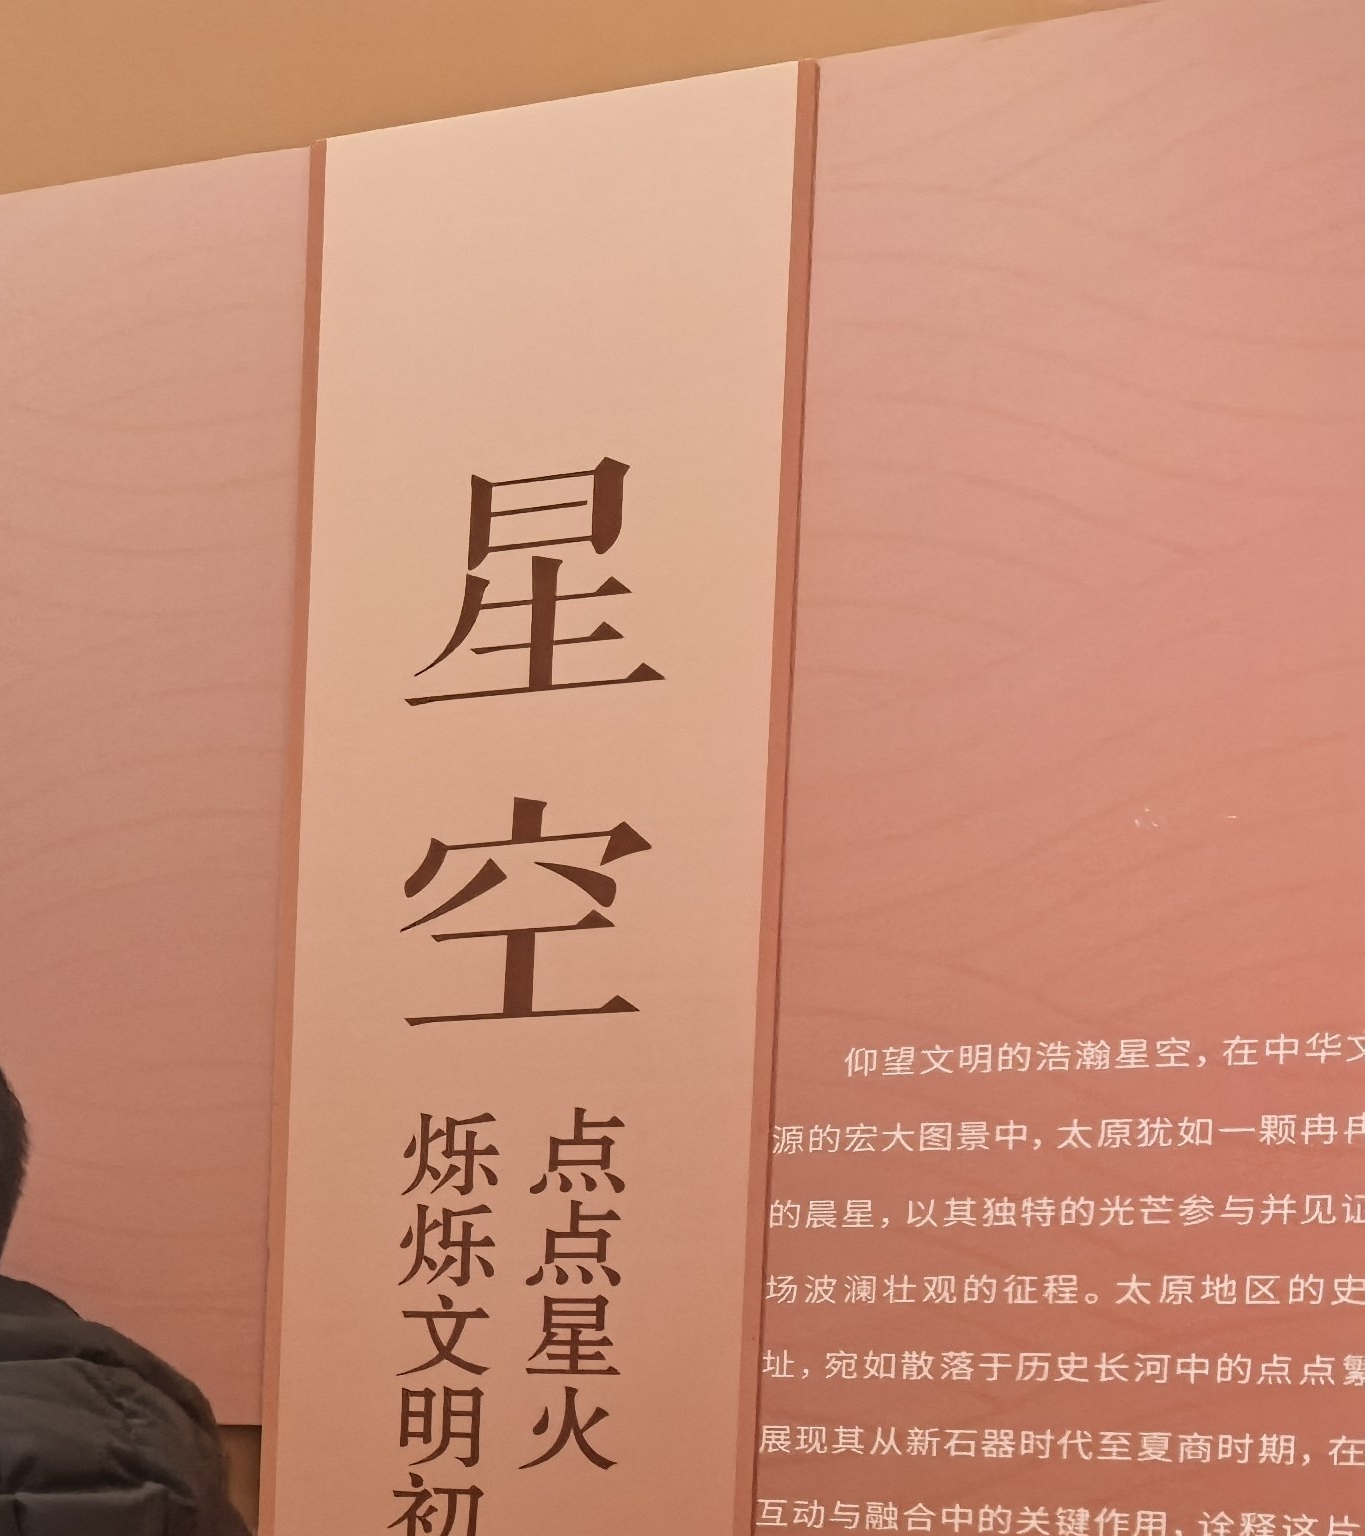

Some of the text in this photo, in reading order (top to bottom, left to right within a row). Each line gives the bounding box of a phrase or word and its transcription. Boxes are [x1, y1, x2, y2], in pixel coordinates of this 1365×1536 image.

[400, 456, 666, 1027] 星空
[518, 1107, 626, 1472] 点点星火
[766, 1273, 1365, 1307] 场波澜壮观的征程。太原地区的史
[759, 1425, 1365, 1467] 展现其从新石器时代至夏商时期，在
